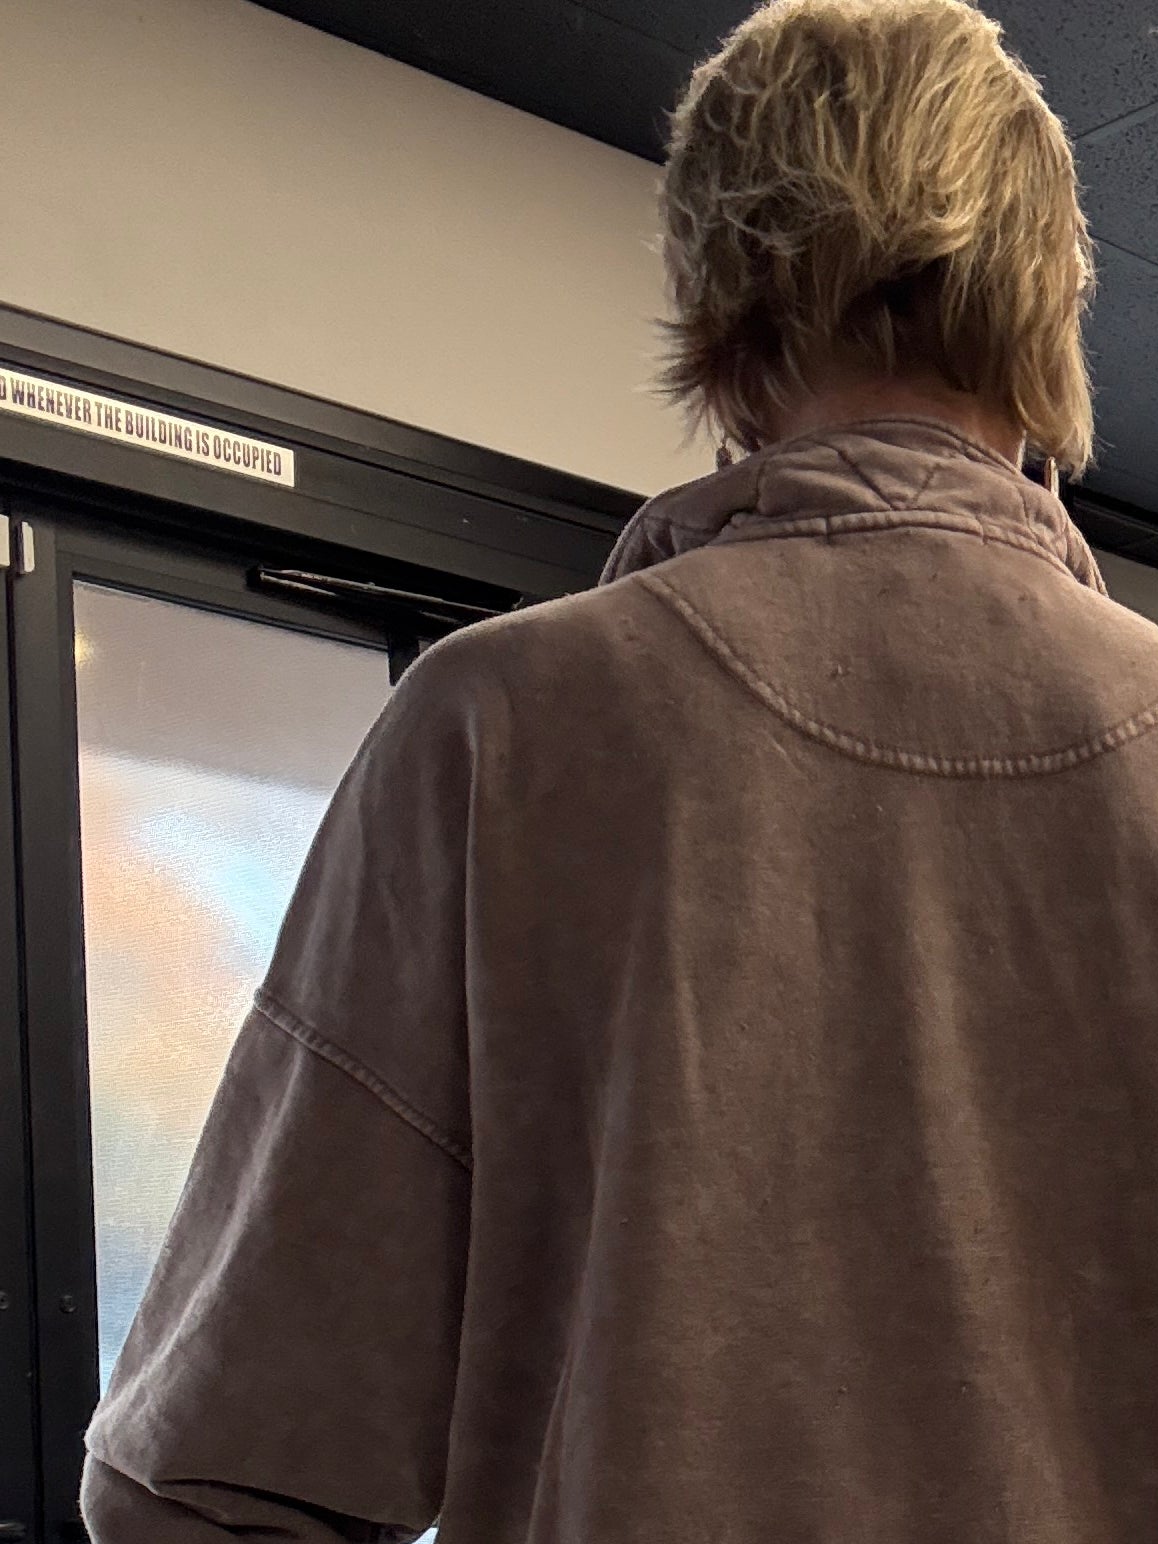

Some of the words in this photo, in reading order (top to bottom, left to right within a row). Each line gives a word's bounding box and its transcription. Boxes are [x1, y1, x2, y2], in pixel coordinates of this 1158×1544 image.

[10, 377, 91, 424] WHENEVER
[95, 401, 122, 432] THE
[125, 410, 192, 452] BUILDING
[196, 430, 209, 457] IS
[213, 435, 282, 475] OCCUPIED
